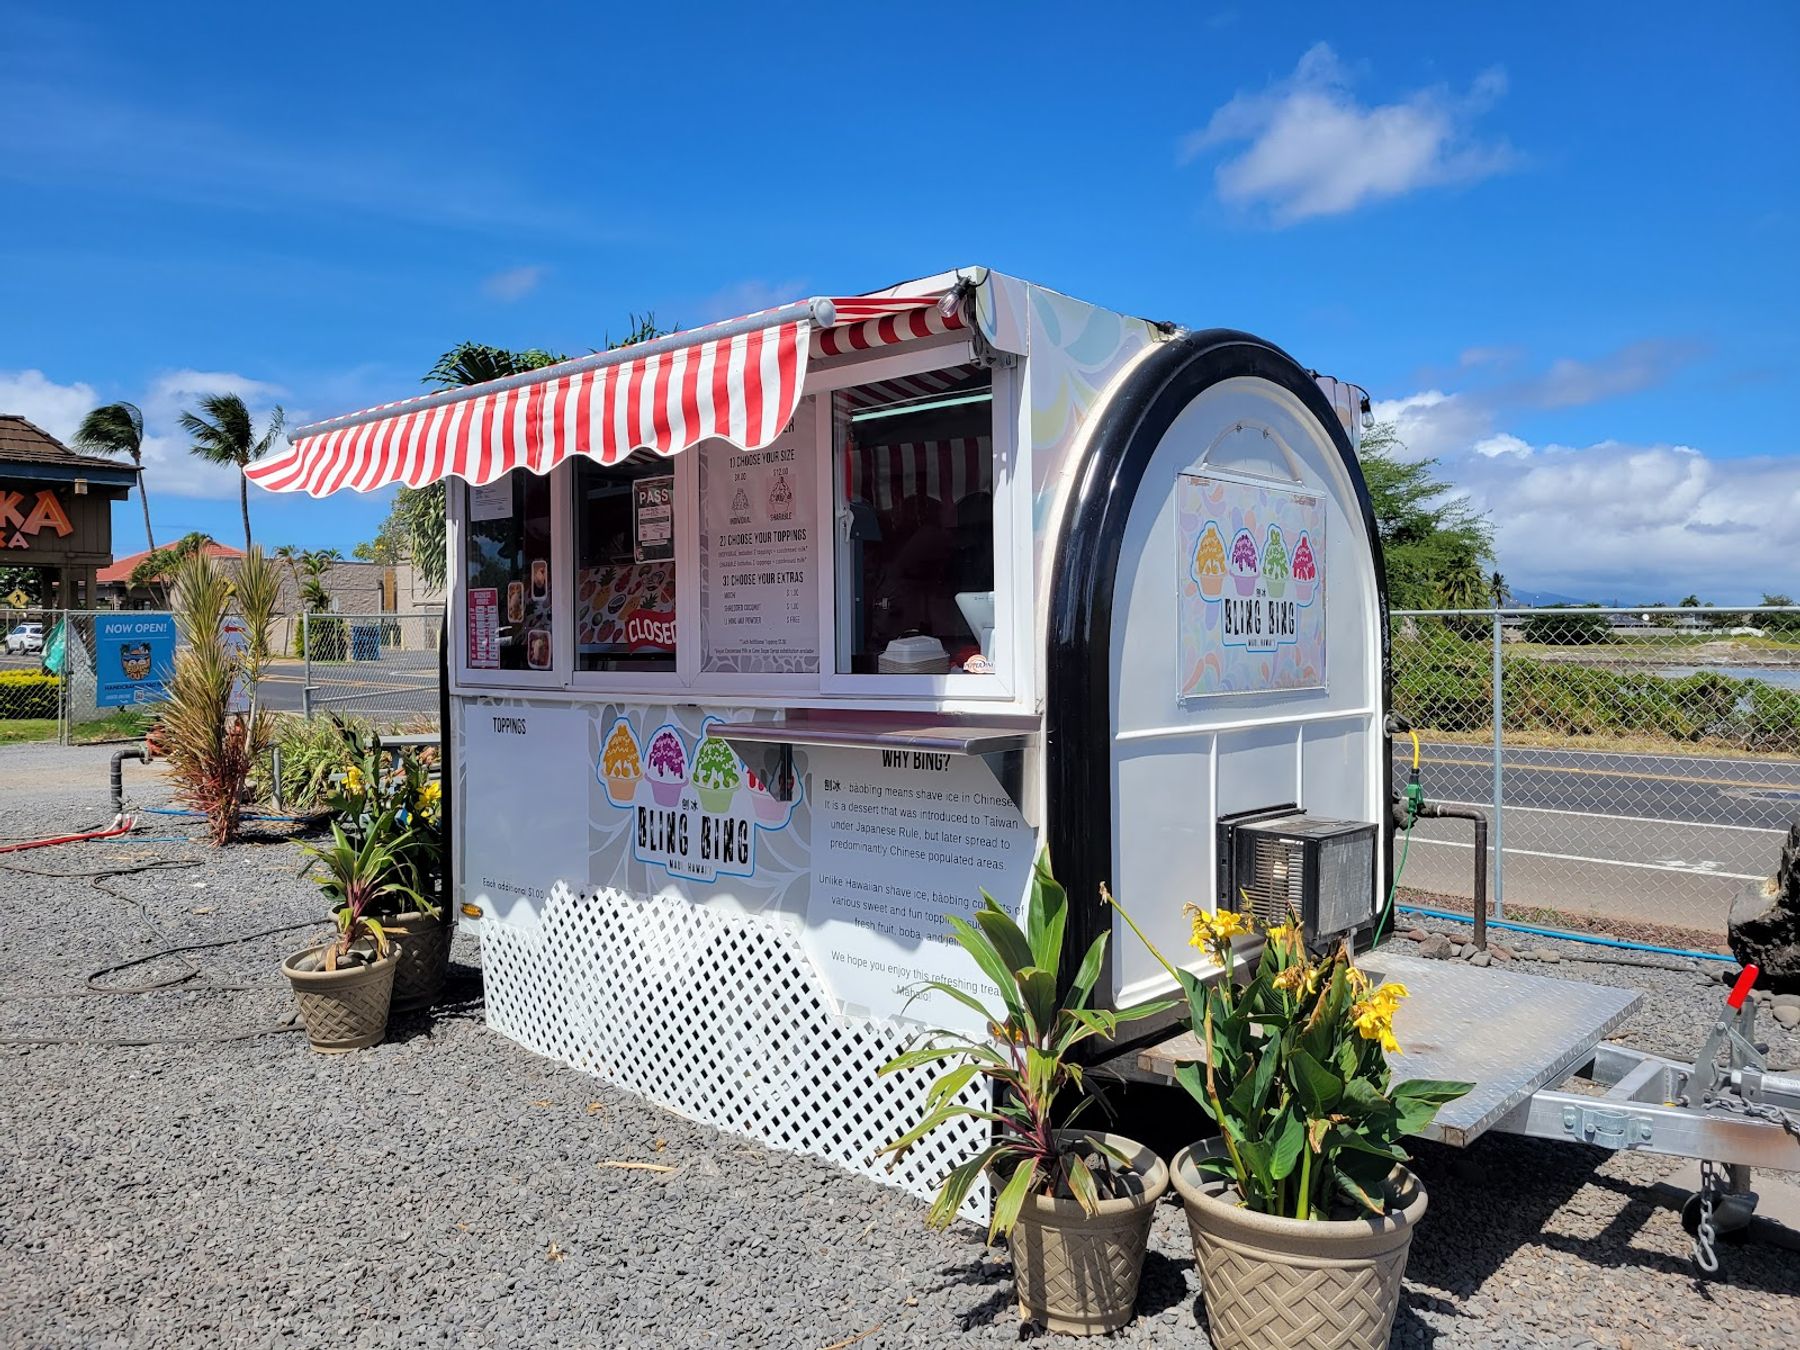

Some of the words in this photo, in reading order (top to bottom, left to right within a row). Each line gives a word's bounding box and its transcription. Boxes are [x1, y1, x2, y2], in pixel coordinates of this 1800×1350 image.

[736, 453, 760, 467] CHOOSE
[761, 451, 779, 463] YOUR
[780, 449, 795, 461] SIZE
[639, 488, 669, 505] PASS
[727, 533, 753, 546] CHOOSE
[754, 531, 772, 544] YOUR
[773, 528, 807, 542] TOPPINGS
[731, 573, 756, 586] CHOOSE
[757, 572, 775, 585] YOUR
[777, 571, 804, 583] EXTRAS
[1225, 598, 1261, 635] BLING
[1268, 600, 1295, 635] BING
[104, 623, 133, 634] NOW
[134, 623, 167, 633] OPEN!
[492, 717, 527, 735] TOPPINGS
[882, 749, 909, 768] WHY
[913, 750, 950, 772] BING?
[885, 787, 913, 798] means
[916, 788, 943, 800] shave
[946, 792, 959, 802] ice
[961, 792, 970, 802] in
[824, 799, 830, 809] It
[832, 800, 839, 810] is
[841, 803, 846, 811] a
[848, 802, 879, 814] dessert
[881, 805, 897, 817] that
[900, 809, 917, 819] was
[920, 808, 968, 824] introduced
[971, 814, 980, 825] to
[984, 815, 1018, 829] Taiwan
[638, 806, 689, 857] BLING
[701, 815, 748, 864] BING
[831, 820, 853, 831] under
[856, 822, 896, 836] Japanese
[899, 827, 921, 840] Rule,
[924, 829, 939, 841] but
[941, 831, 961, 843] later
[965, 836, 997, 849] spread
[1001, 839, 1010, 850] to
[889, 845, 926, 860] Chinese
[928, 851, 974, 866] populated
[976, 858, 1007, 871] areas.
[482, 877, 496, 888] Each
[818, 873, 843, 886] Unlike
[846, 878, 883, 893] Hawaiian
[885, 885, 911, 898] shave
[913, 888, 929, 902] ice,
[1014, 904, 1025, 916] of
[831, 896, 861, 909] various
[862, 901, 888, 913] sweet
[889, 906, 906, 917] and
[908, 907, 923, 919] fun
[854, 916, 875, 930] fresh
[877, 921, 896, 936] fruit,
[899, 926, 923, 941] boba,
[927, 932, 943, 944] and
[831, 950, 845, 962] We
[847, 953, 868, 968] hope
[869, 960, 886, 972] you
[887, 965, 911, 979] enjoy
[913, 968, 929, 981] this
[931, 973, 978, 995] refreshing
[896, 984, 932, 1002] Mahalo!
